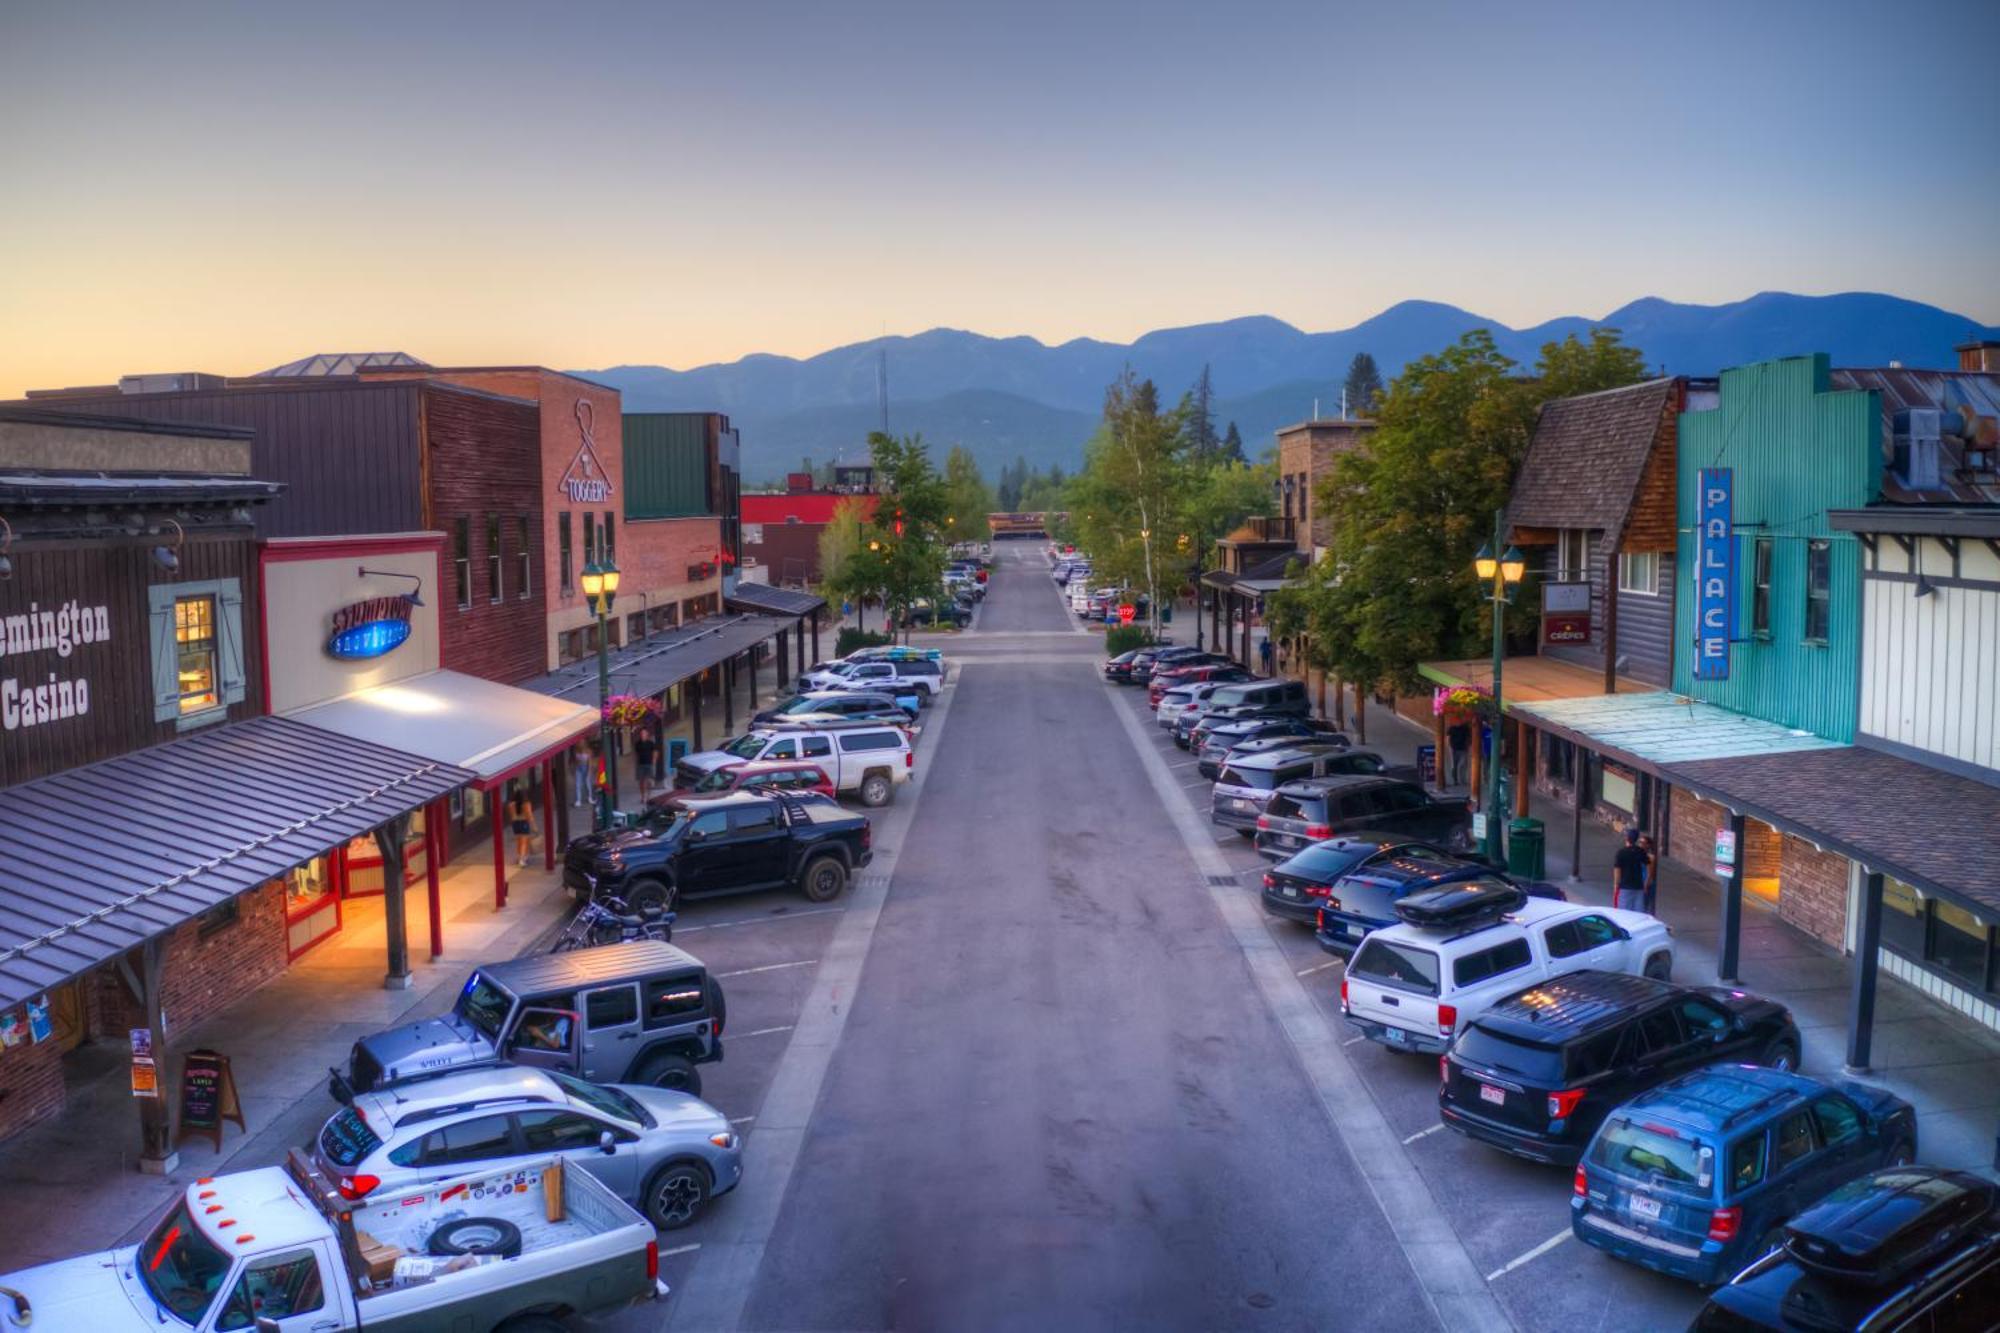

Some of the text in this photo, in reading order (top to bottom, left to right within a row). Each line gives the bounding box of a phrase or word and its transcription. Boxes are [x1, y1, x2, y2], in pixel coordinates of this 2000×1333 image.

[567, 478, 608, 502] TOGGERY
[1704, 488, 1727, 658] PALACE
[1119, 607, 1135, 616] STOP
[1, 672, 89, 730] Casino
